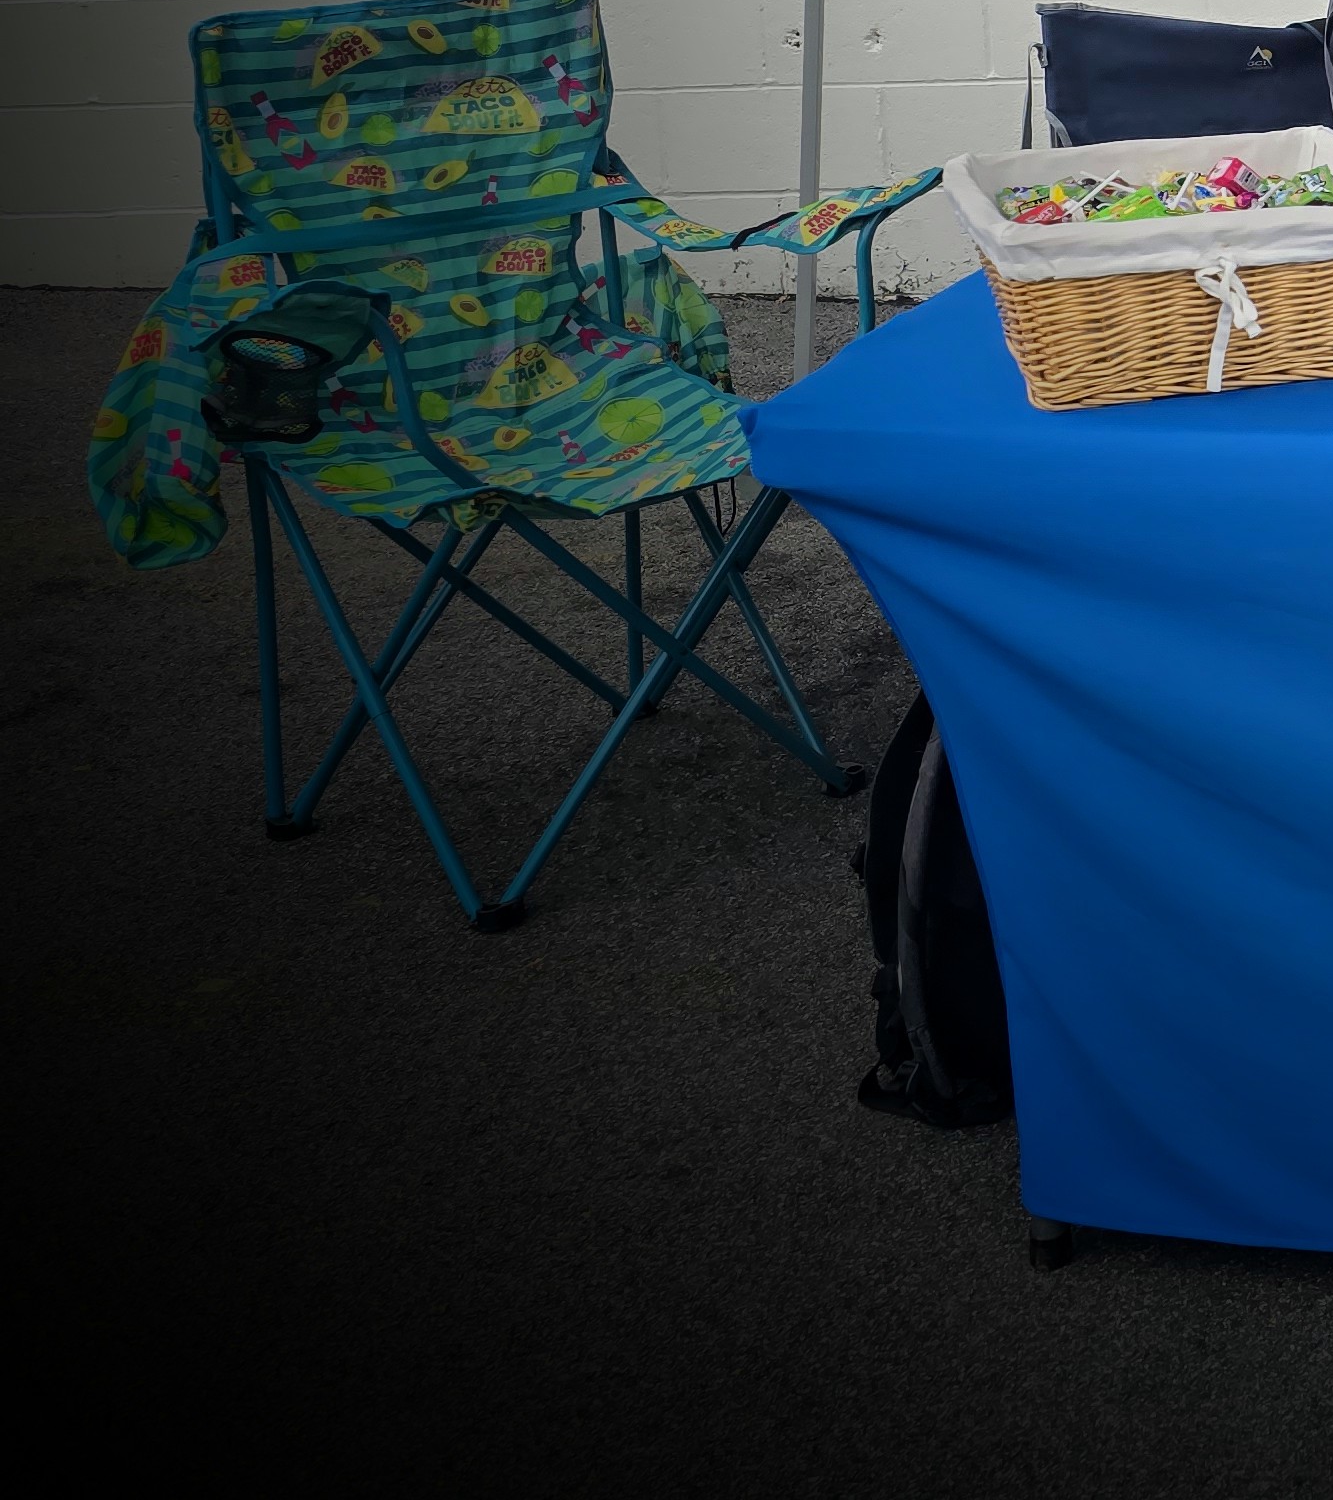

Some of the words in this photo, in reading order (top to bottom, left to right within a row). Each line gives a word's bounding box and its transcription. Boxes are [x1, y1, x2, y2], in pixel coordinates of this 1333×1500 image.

[320, 35, 362, 63] TACO
[322, 48, 357, 77] BOUT
[449, 96, 516, 116] TACO
[346, 174, 379, 187] BOUT
[351, 164, 386, 178] TACO
[804, 202, 838, 227] TACO
[809, 211, 841, 237] BOUT
[495, 260, 536, 273] BOUT
[538, 258, 546, 272] it
[500, 248, 547, 261] TACO
[503, 358, 547, 384] TACO
